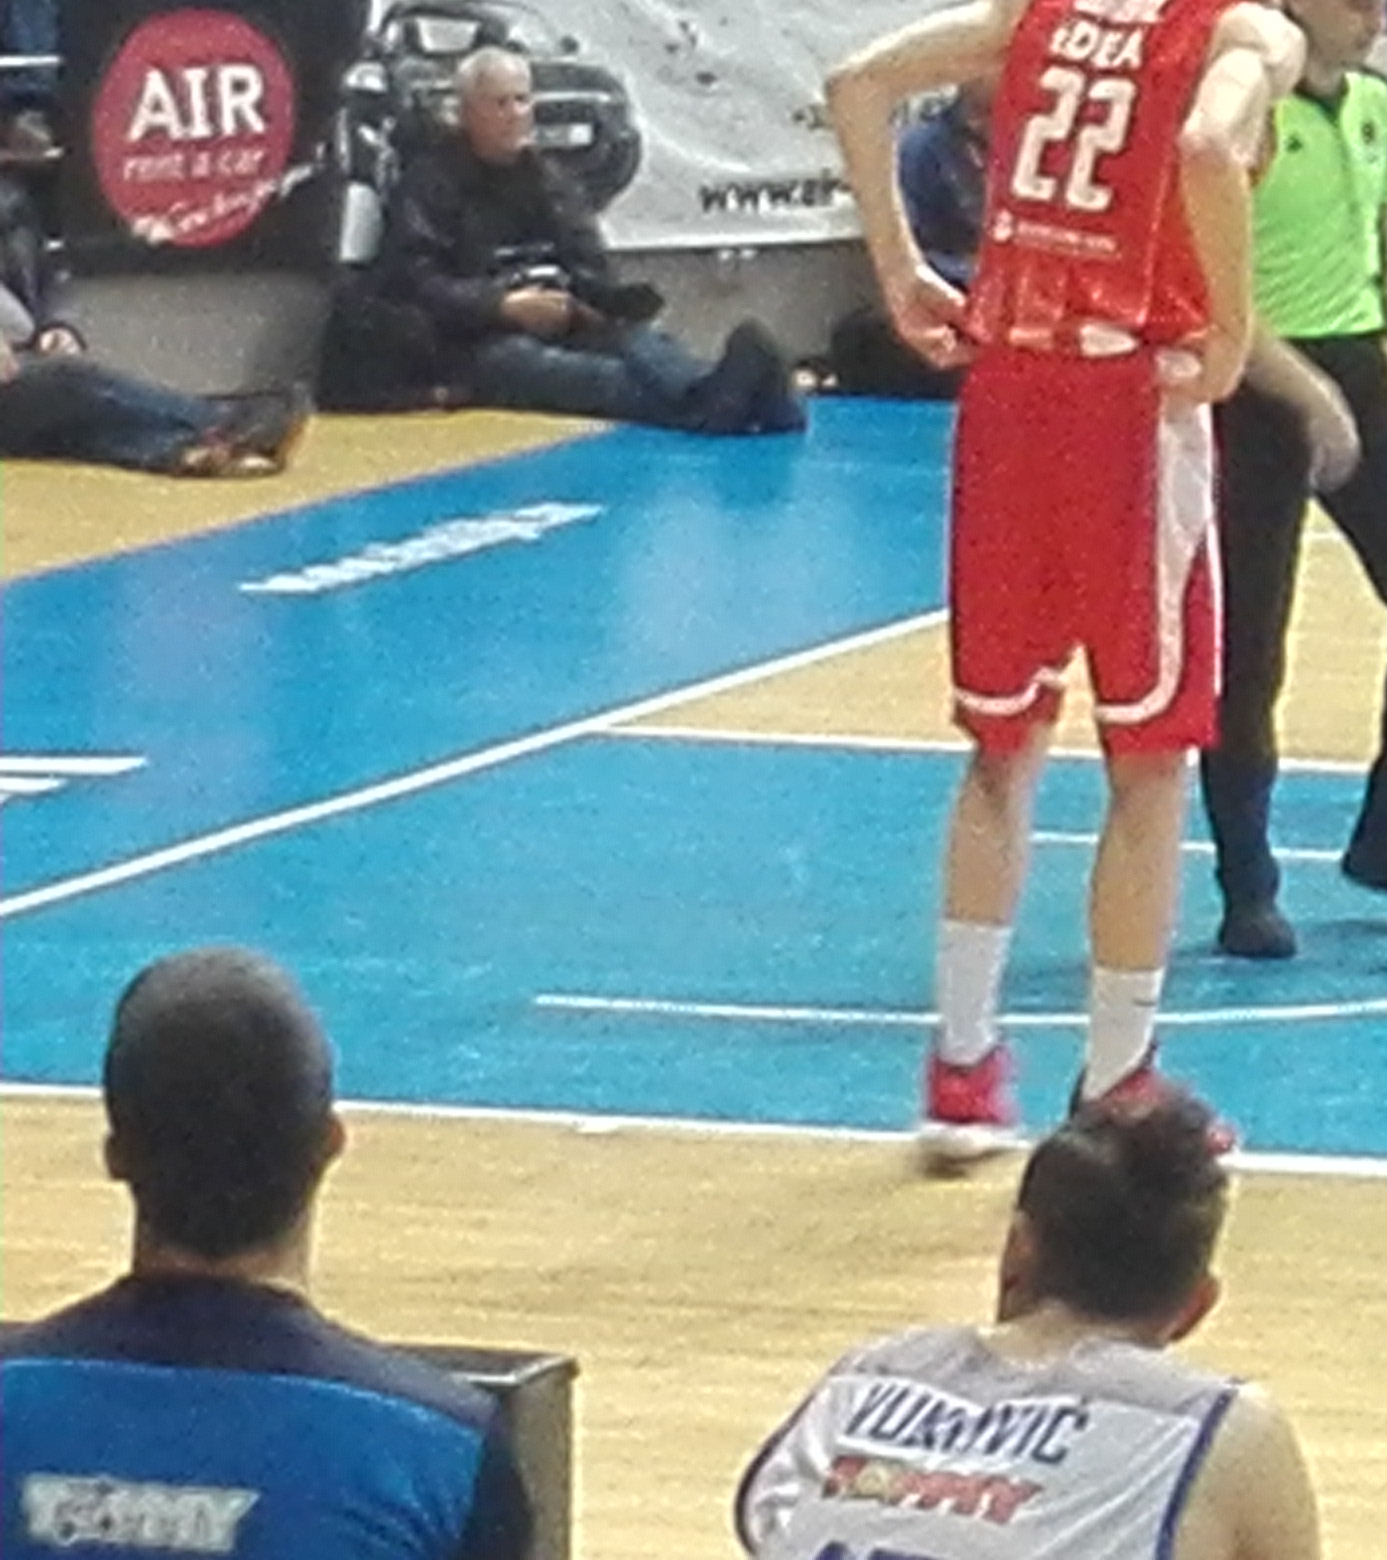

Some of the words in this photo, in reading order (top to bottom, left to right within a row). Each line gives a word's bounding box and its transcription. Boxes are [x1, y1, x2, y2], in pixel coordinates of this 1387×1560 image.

[127, 62, 268, 142] AIR
[1011, 64, 1139, 214] 22
[122, 150, 185, 182] rent
[190, 151, 212, 177] a
[217, 148, 268, 176] car
